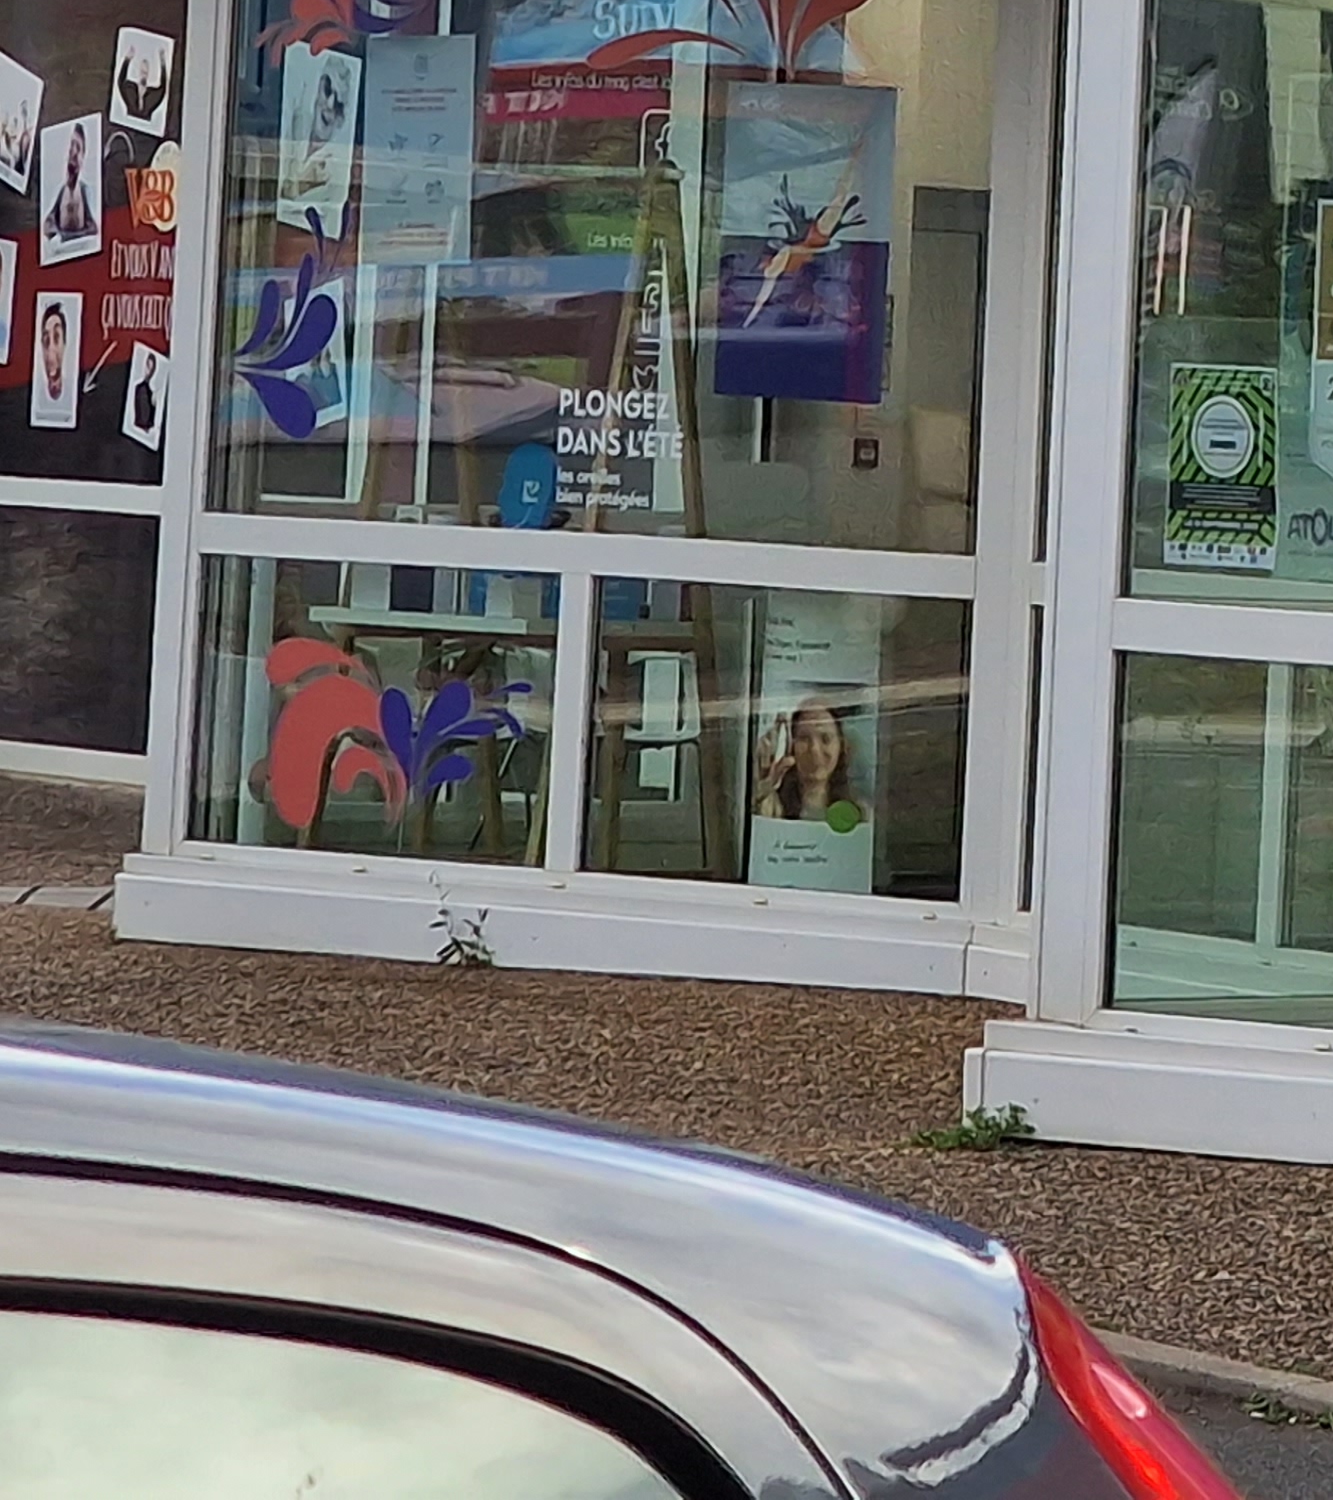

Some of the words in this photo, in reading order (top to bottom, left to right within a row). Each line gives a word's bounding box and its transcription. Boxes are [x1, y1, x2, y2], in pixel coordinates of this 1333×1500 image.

[124, 168, 175, 230] V&B
[558, 388, 671, 420] PLONGEZ
[557, 426, 621, 457] DANS
[624, 423, 685, 460] L'ÉTÉ
